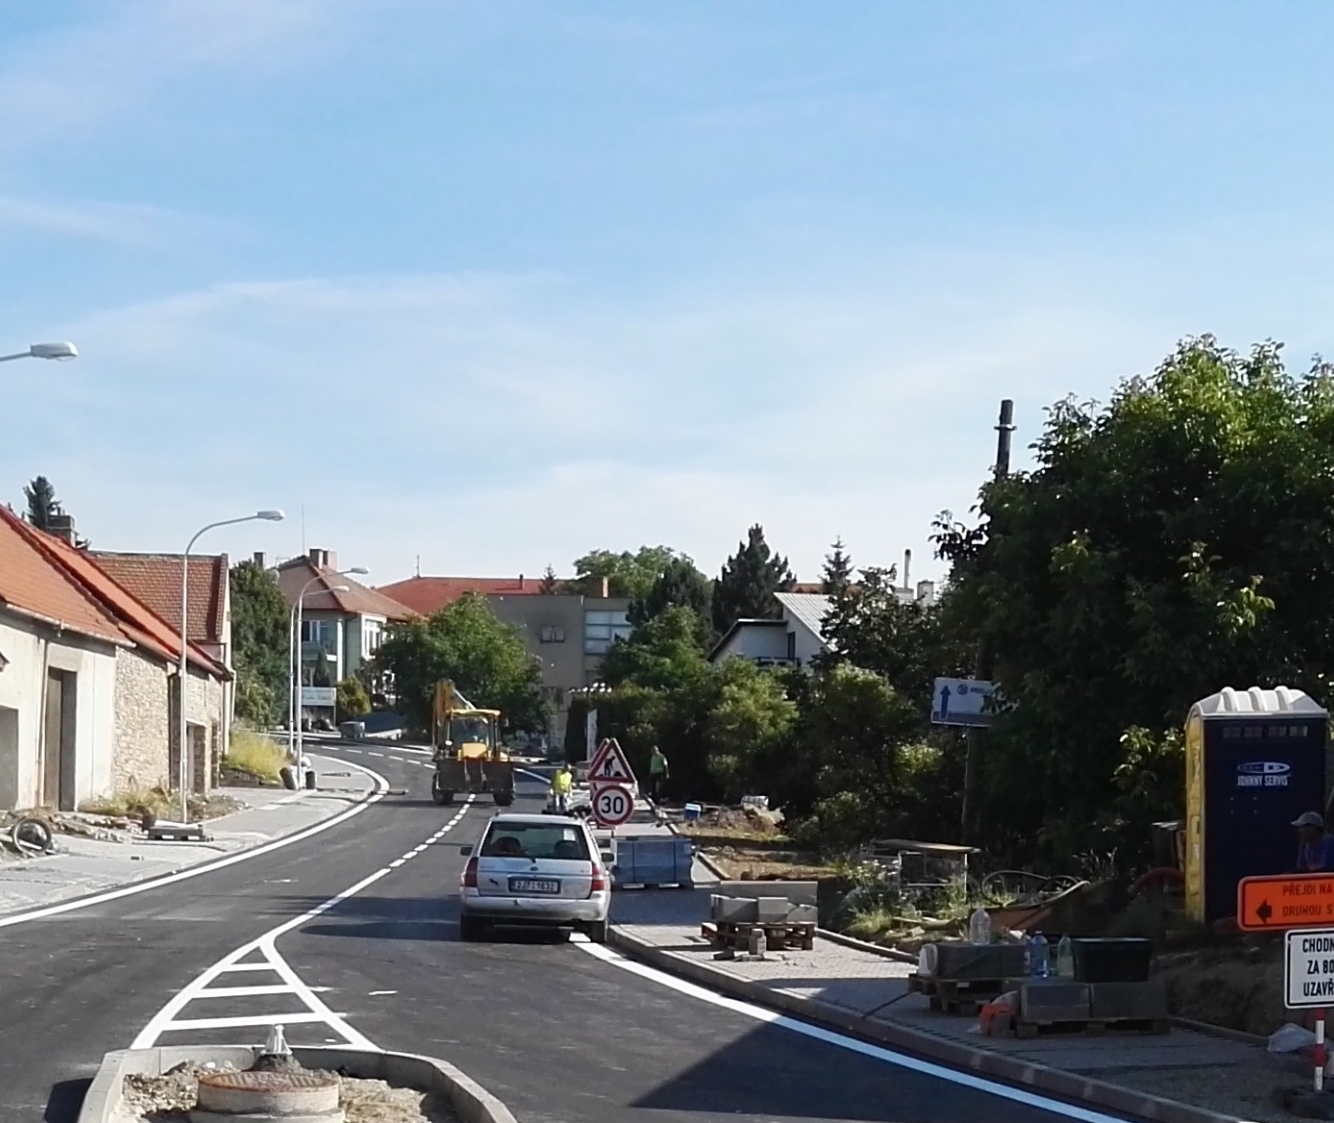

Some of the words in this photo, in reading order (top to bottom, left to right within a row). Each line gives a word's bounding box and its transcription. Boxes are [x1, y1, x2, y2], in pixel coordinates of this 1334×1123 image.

[1237, 775, 1263, 786] JOHNNY
[1264, 775, 1288, 786] SERVIS
[601, 796, 624, 814] 30
[1319, 883, 1333, 895] NA
[1282, 904, 1322, 917] DRUHOU
[1307, 959, 1320, 975] ZA
